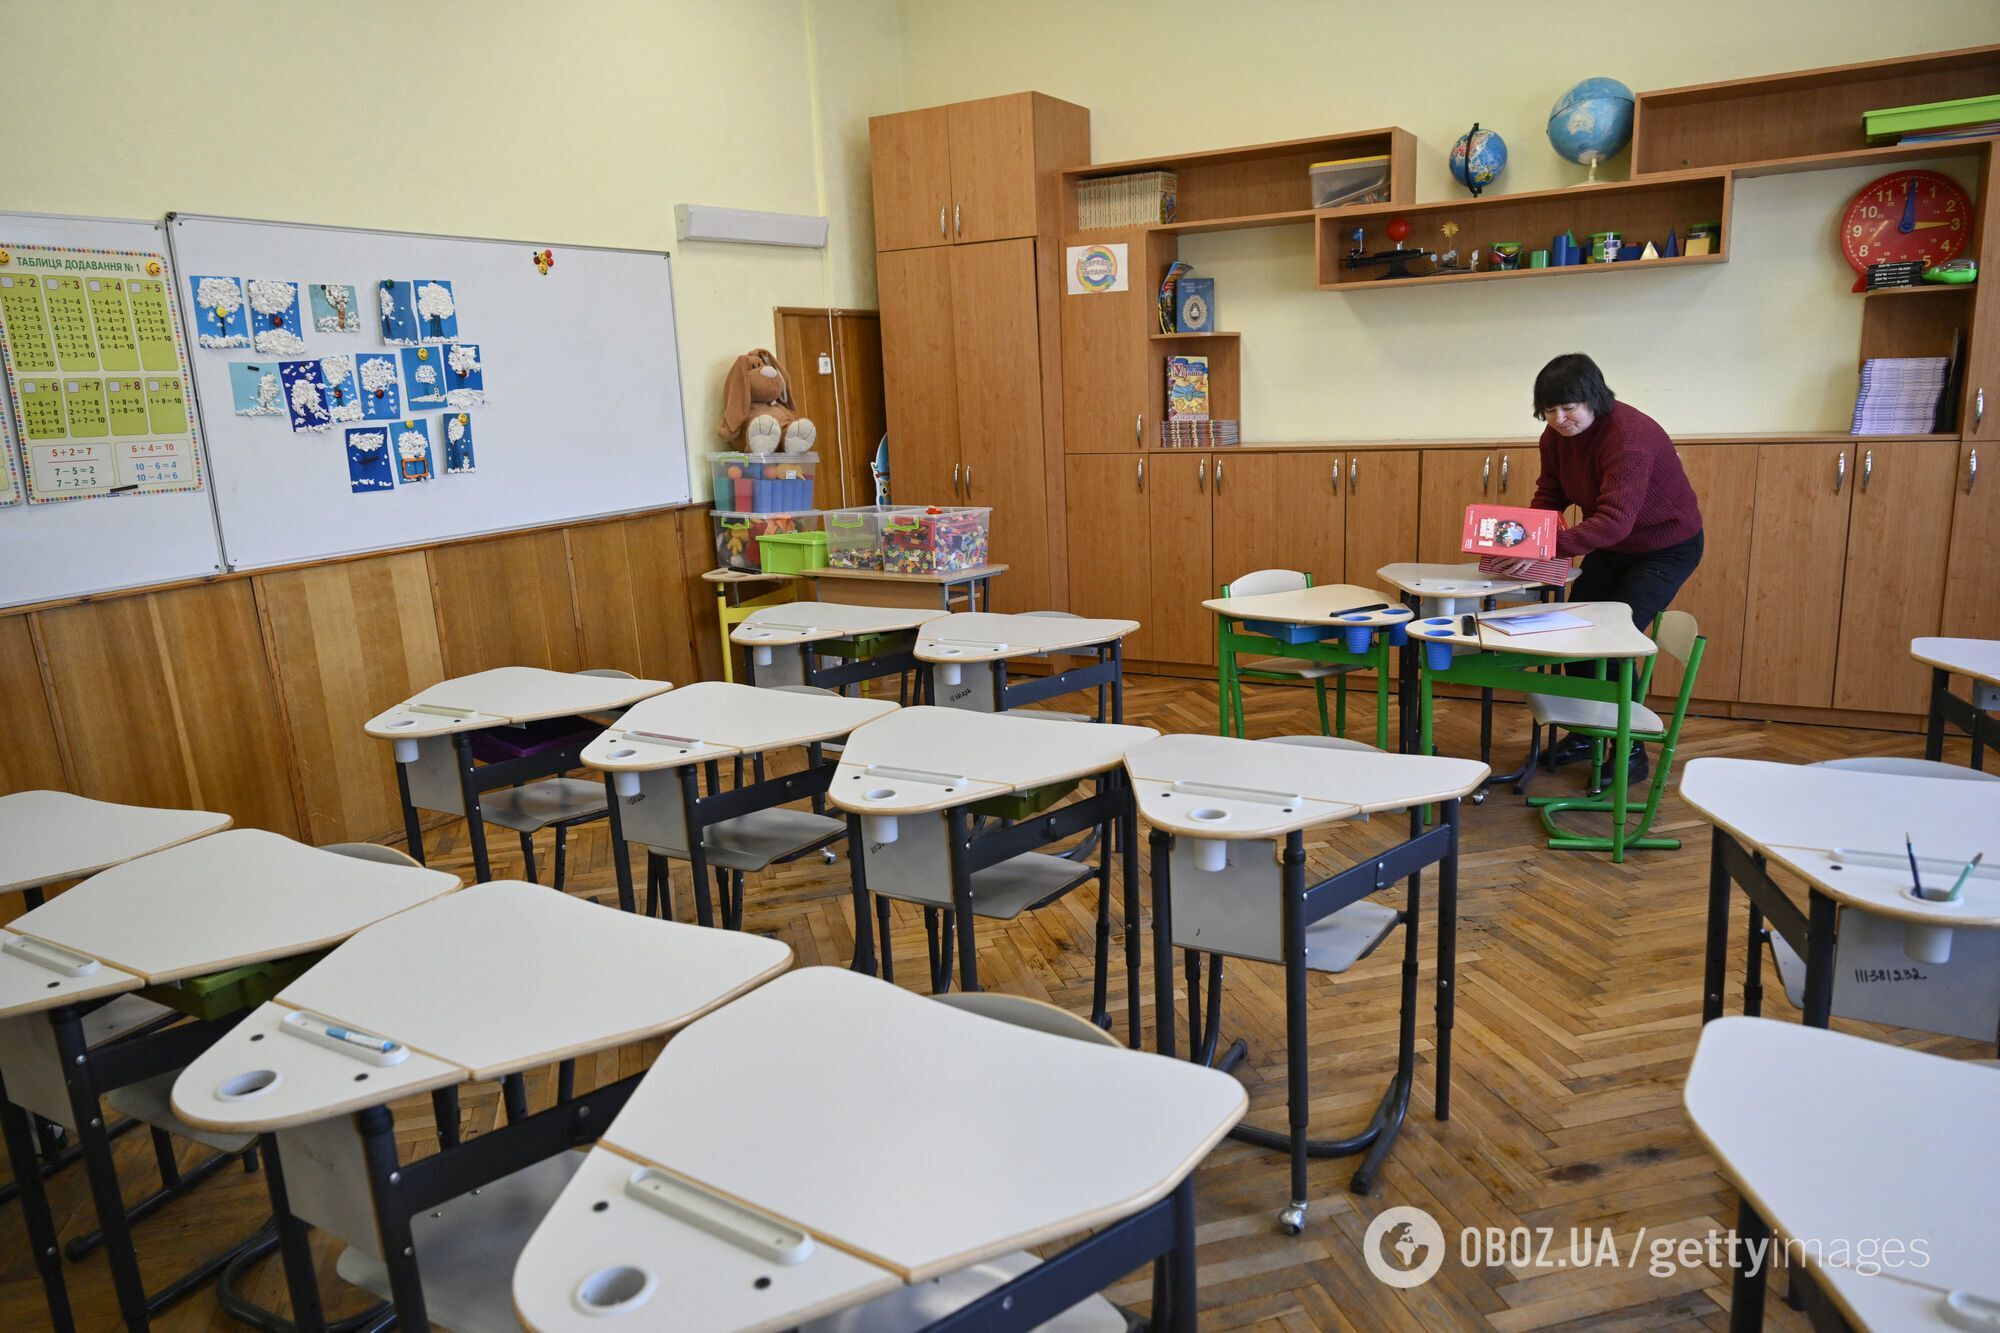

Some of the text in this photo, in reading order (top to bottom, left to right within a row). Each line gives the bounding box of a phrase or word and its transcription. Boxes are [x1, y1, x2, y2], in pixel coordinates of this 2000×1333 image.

[1876, 190, 1894, 202] 11
[1860, 206, 1878, 218] 10
[1946, 200, 1956, 212] 2
[1951, 218, 1960, 230] 3
[1853, 225, 1862, 238] 9
[1859, 245, 1868, 257] 8
[1941, 240, 1950, 252] 4
[16, 257, 140, 272] ТАБЛИЦЯ ДОДАВАННЯ № 1
[1922, 255, 1932, 268] 5
